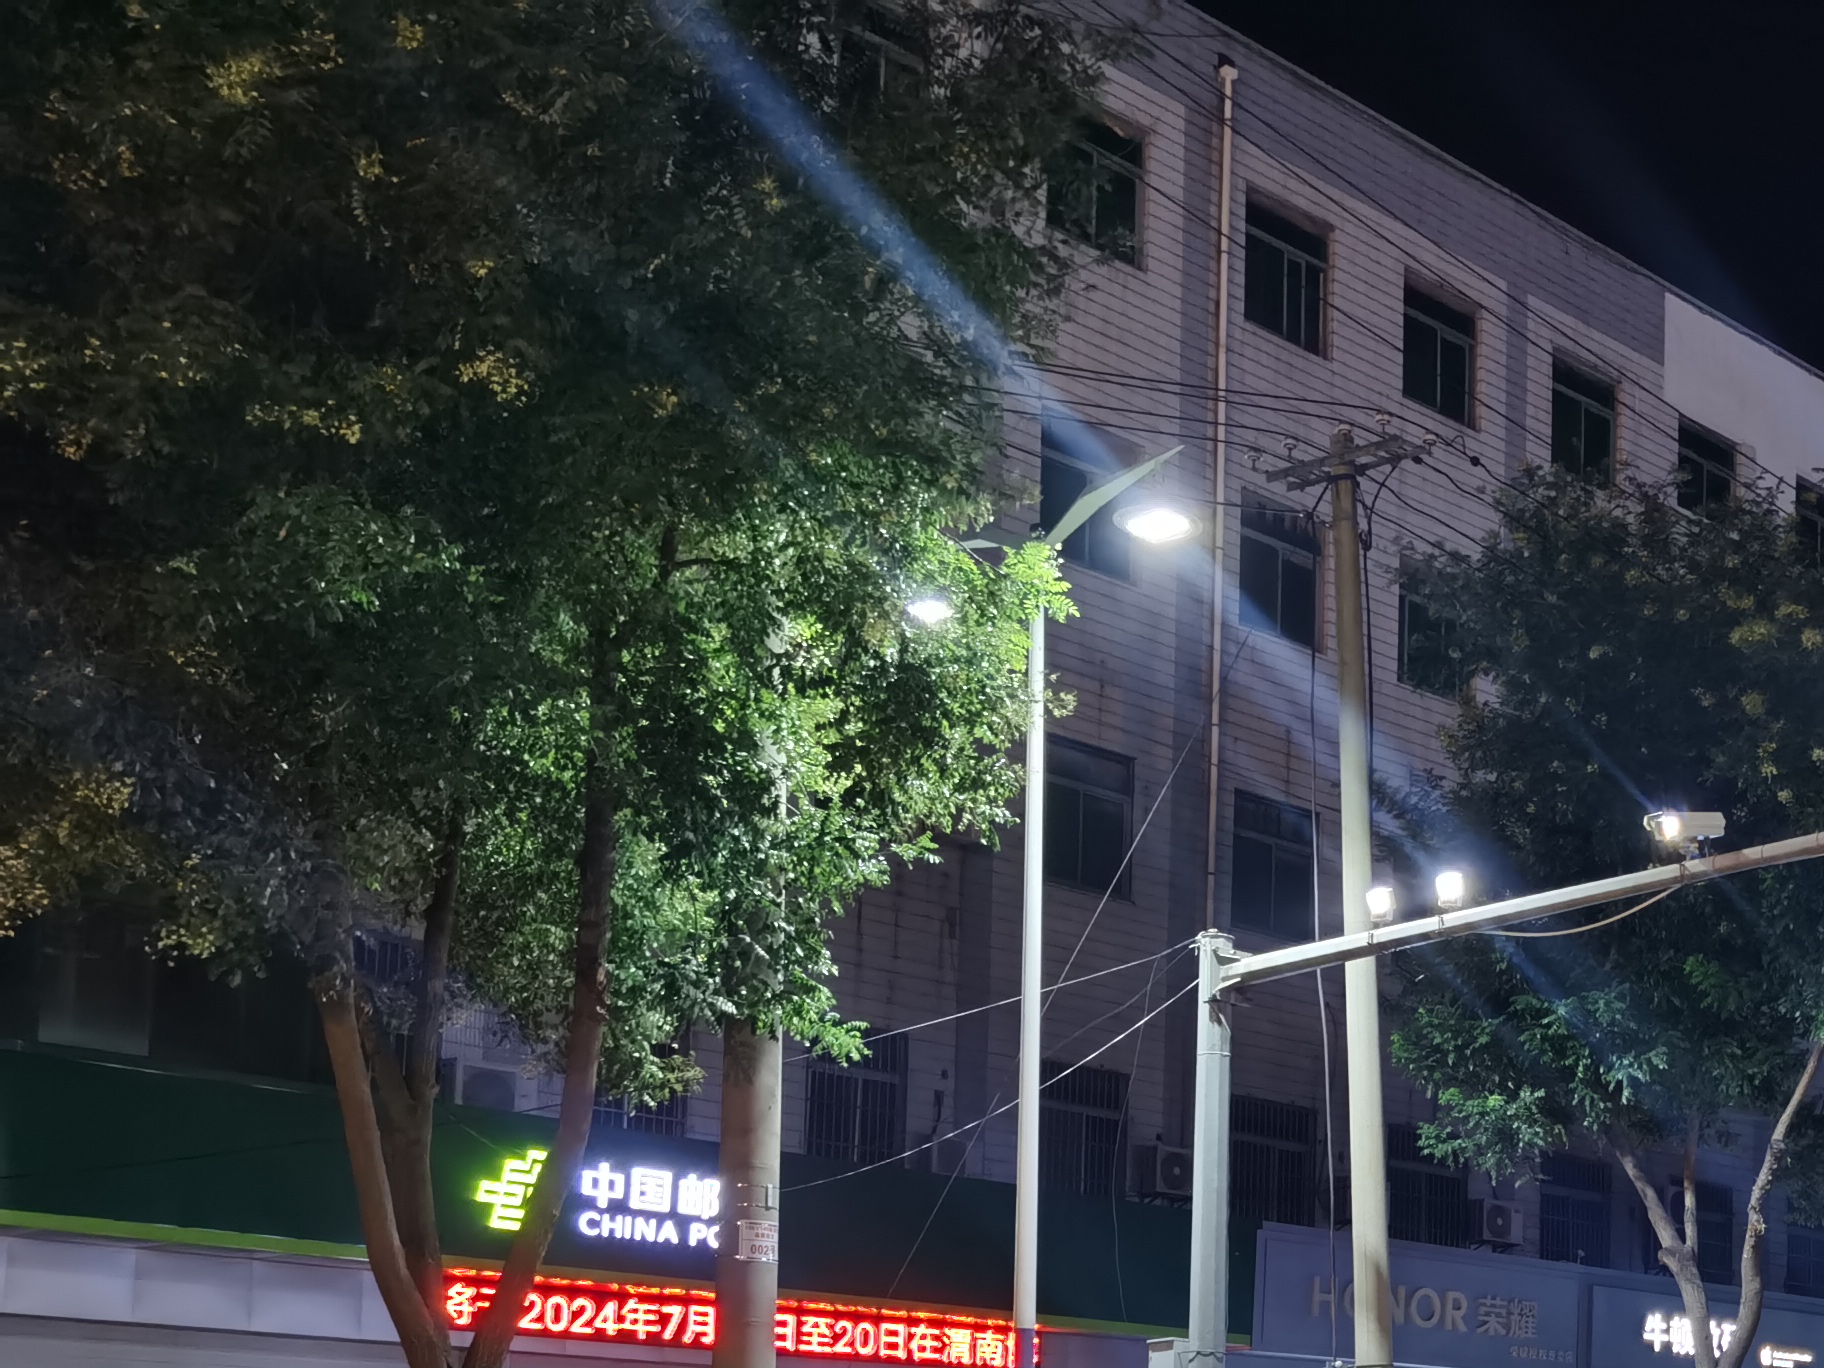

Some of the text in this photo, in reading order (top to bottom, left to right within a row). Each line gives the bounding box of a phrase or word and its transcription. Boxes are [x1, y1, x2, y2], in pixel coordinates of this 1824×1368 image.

[580, 1161, 721, 1220] 中国邮
[578, 1210, 680, 1246] CHINA
[1476, 1295, 1539, 1338] 荣耀
